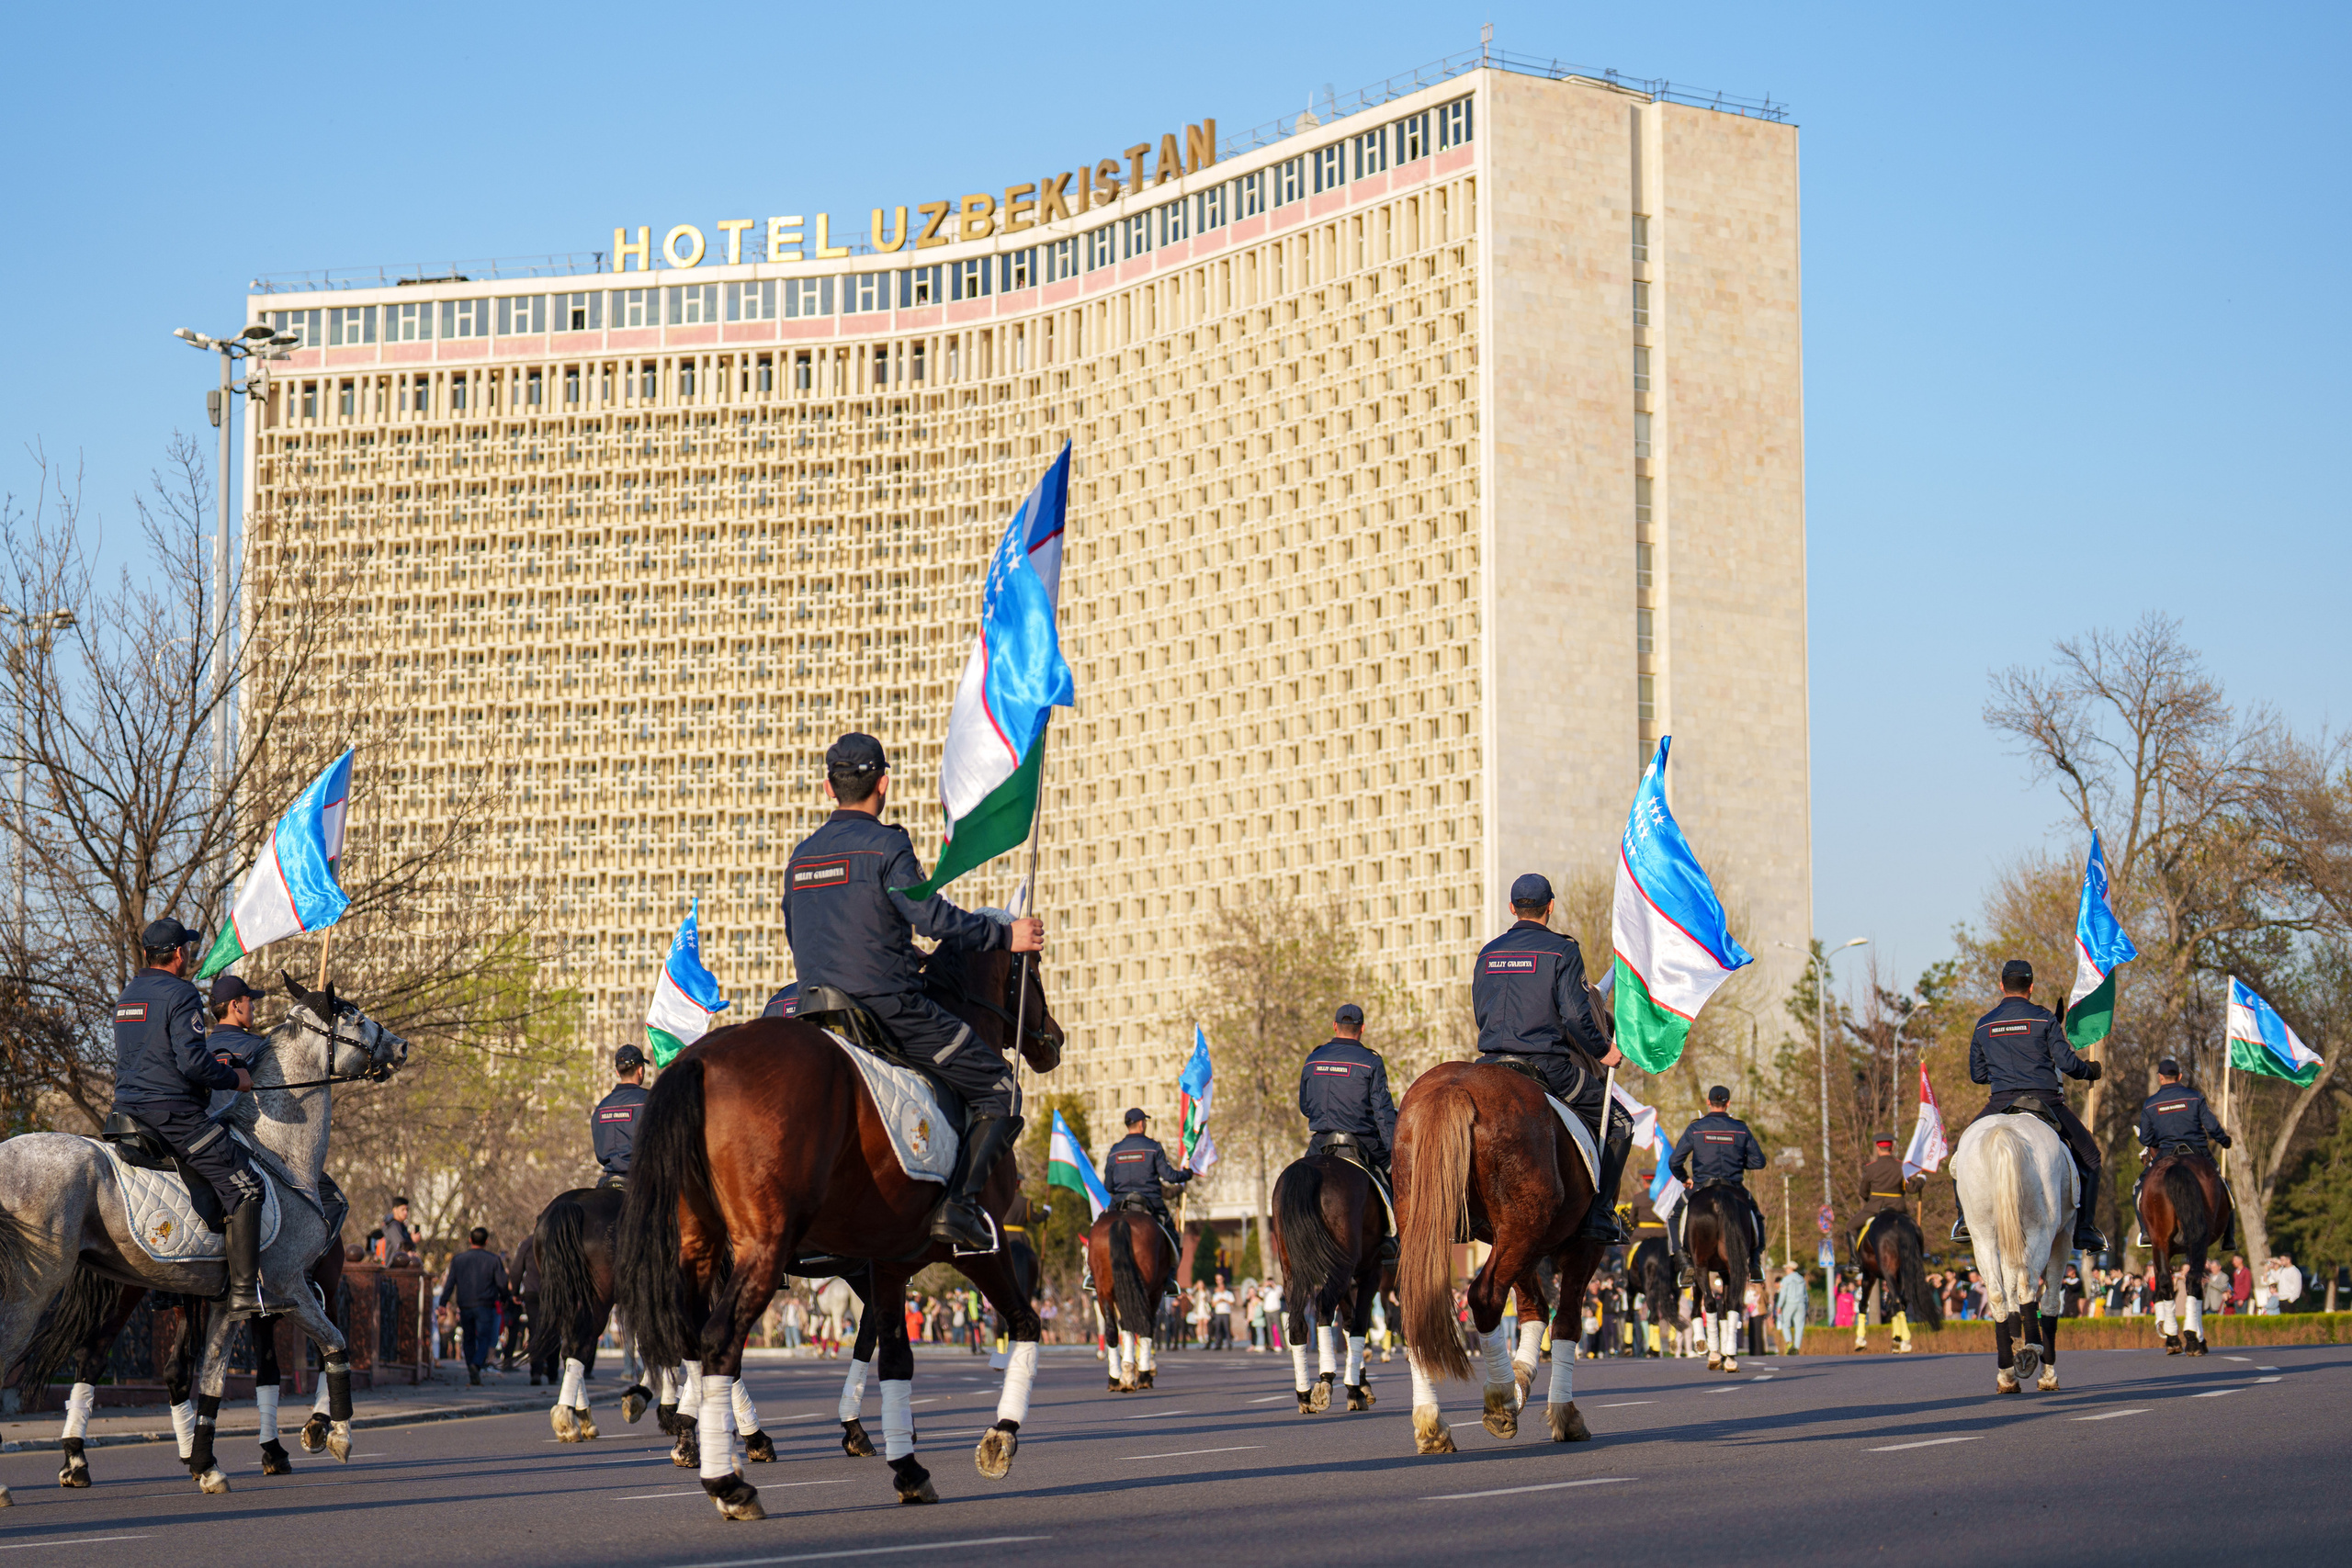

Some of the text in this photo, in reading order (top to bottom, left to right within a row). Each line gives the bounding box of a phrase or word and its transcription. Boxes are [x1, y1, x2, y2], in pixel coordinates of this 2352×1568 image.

[613, 118, 1216, 273] HOTEL UZBEKISTAN
[795, 867, 844, 882] MILLIY GVARDIYA
